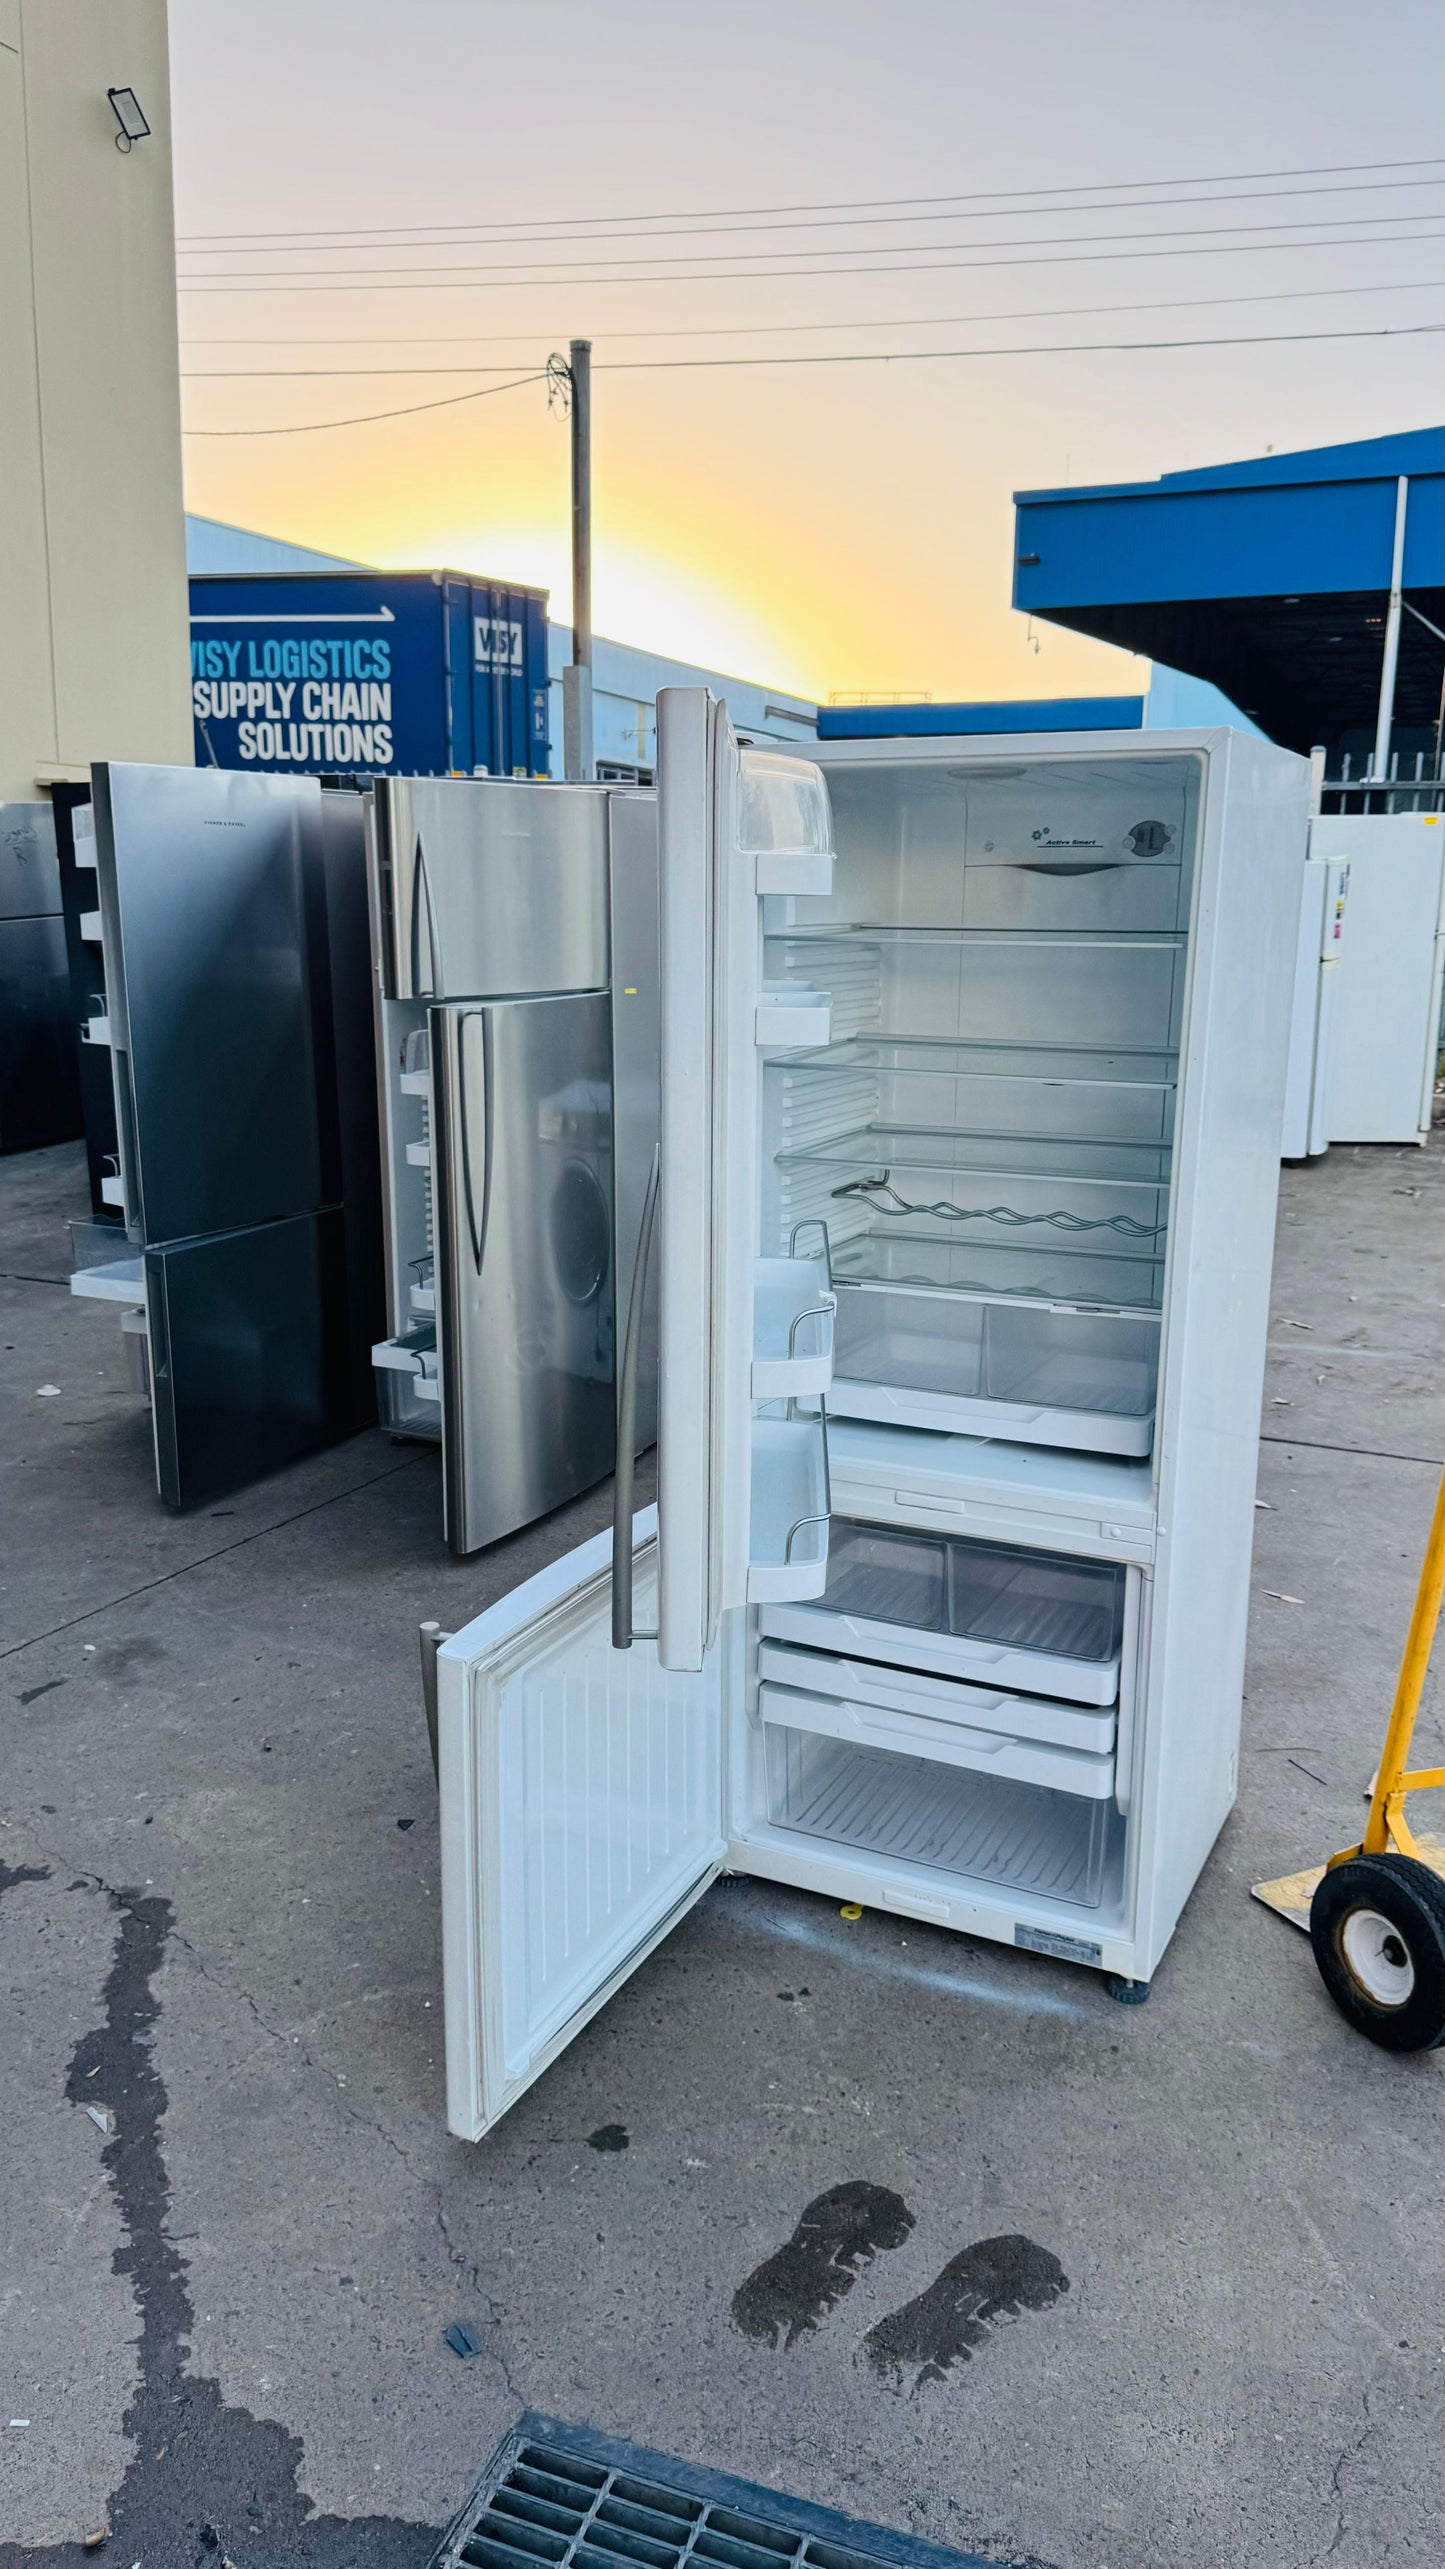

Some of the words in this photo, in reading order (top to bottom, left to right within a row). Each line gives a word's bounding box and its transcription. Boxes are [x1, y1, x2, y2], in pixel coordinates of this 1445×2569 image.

[248, 640, 391, 679] LOGISTICS
[193, 681, 297, 720] SUPPLY
[302, 681, 392, 721] CHAIN
[238, 723, 394, 764] SOLUTIONS
